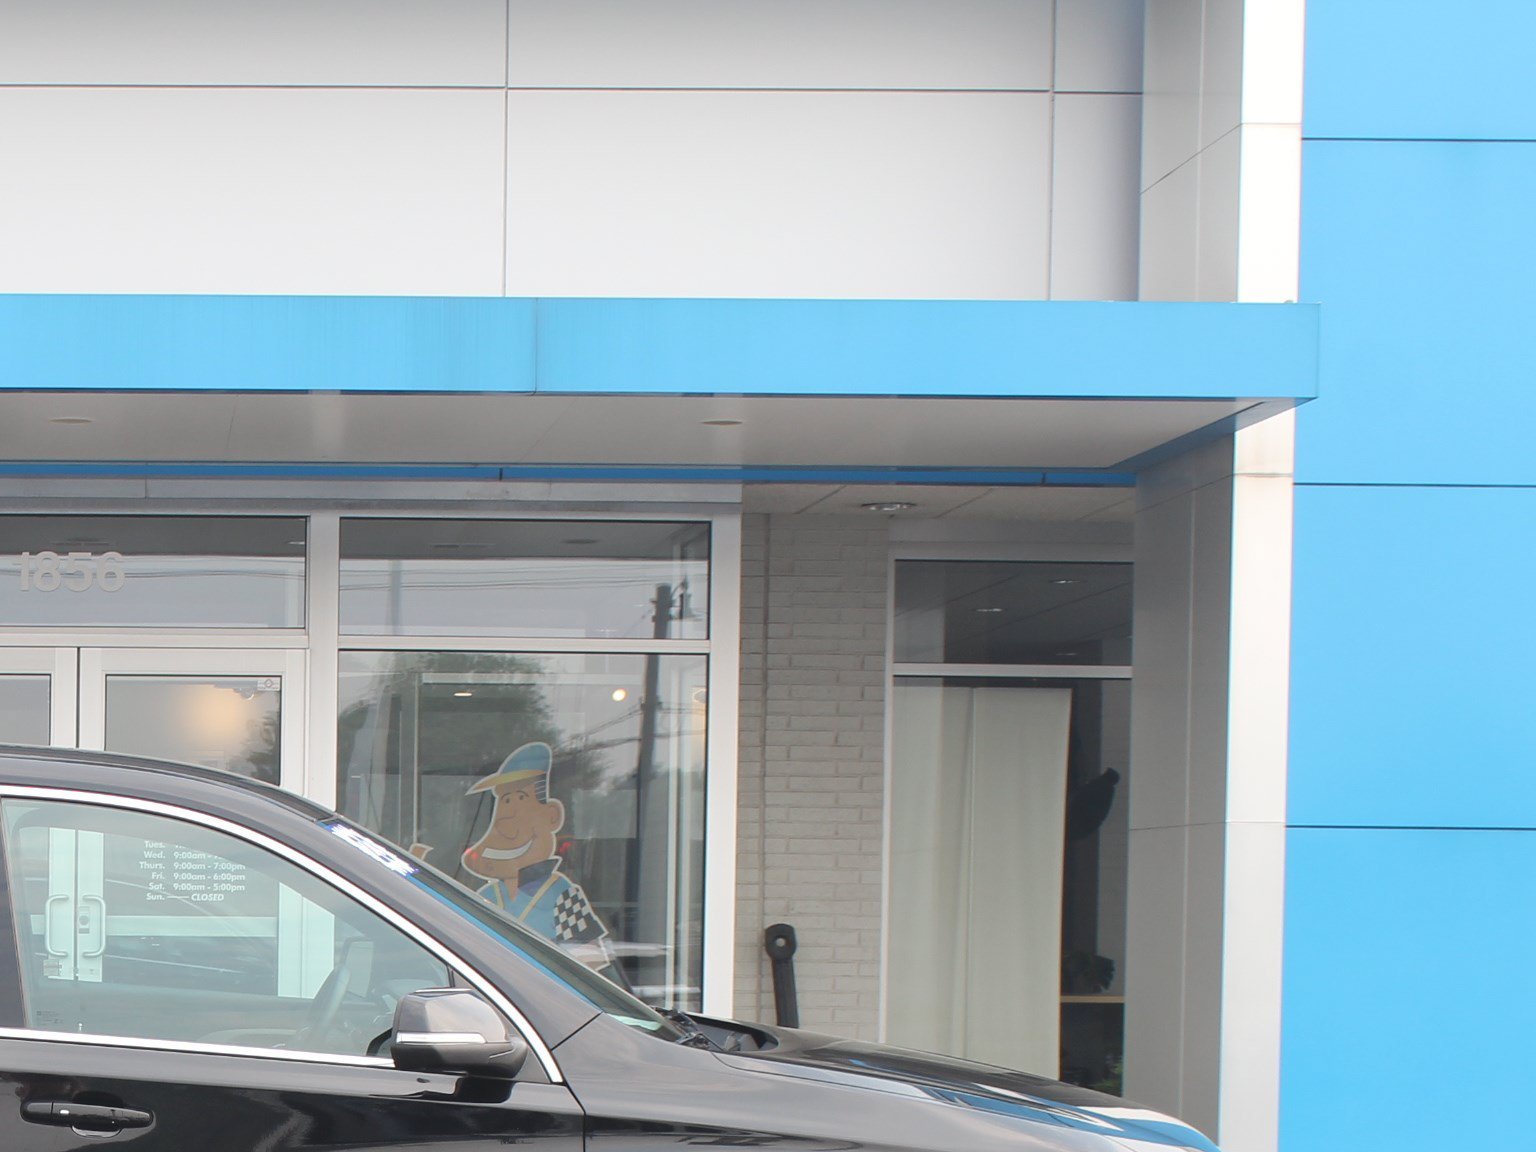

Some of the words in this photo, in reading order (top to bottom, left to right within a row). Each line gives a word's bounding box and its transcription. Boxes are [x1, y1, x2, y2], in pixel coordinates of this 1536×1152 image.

[14, 551, 125, 592] 1856
[144, 850, 166, 859] Wed.
[173, 851, 206, 860] 9:00am
[139, 860, 166, 870] Thurs.
[173, 861, 206, 870] 9:00am
[213, 862, 246, 872] 7:00pm
[151, 871, 166, 880] Fri.
[173, 872, 206, 880] 9:00am
[213, 873, 246, 882] 6:00pm
[148, 882, 165, 891] Sat.
[173, 883, 206, 891] 9:00am
[213, 883, 246, 892] 5:00pm
[146, 892, 165, 901] Sun.
[191, 893, 225, 902] CLOSED
